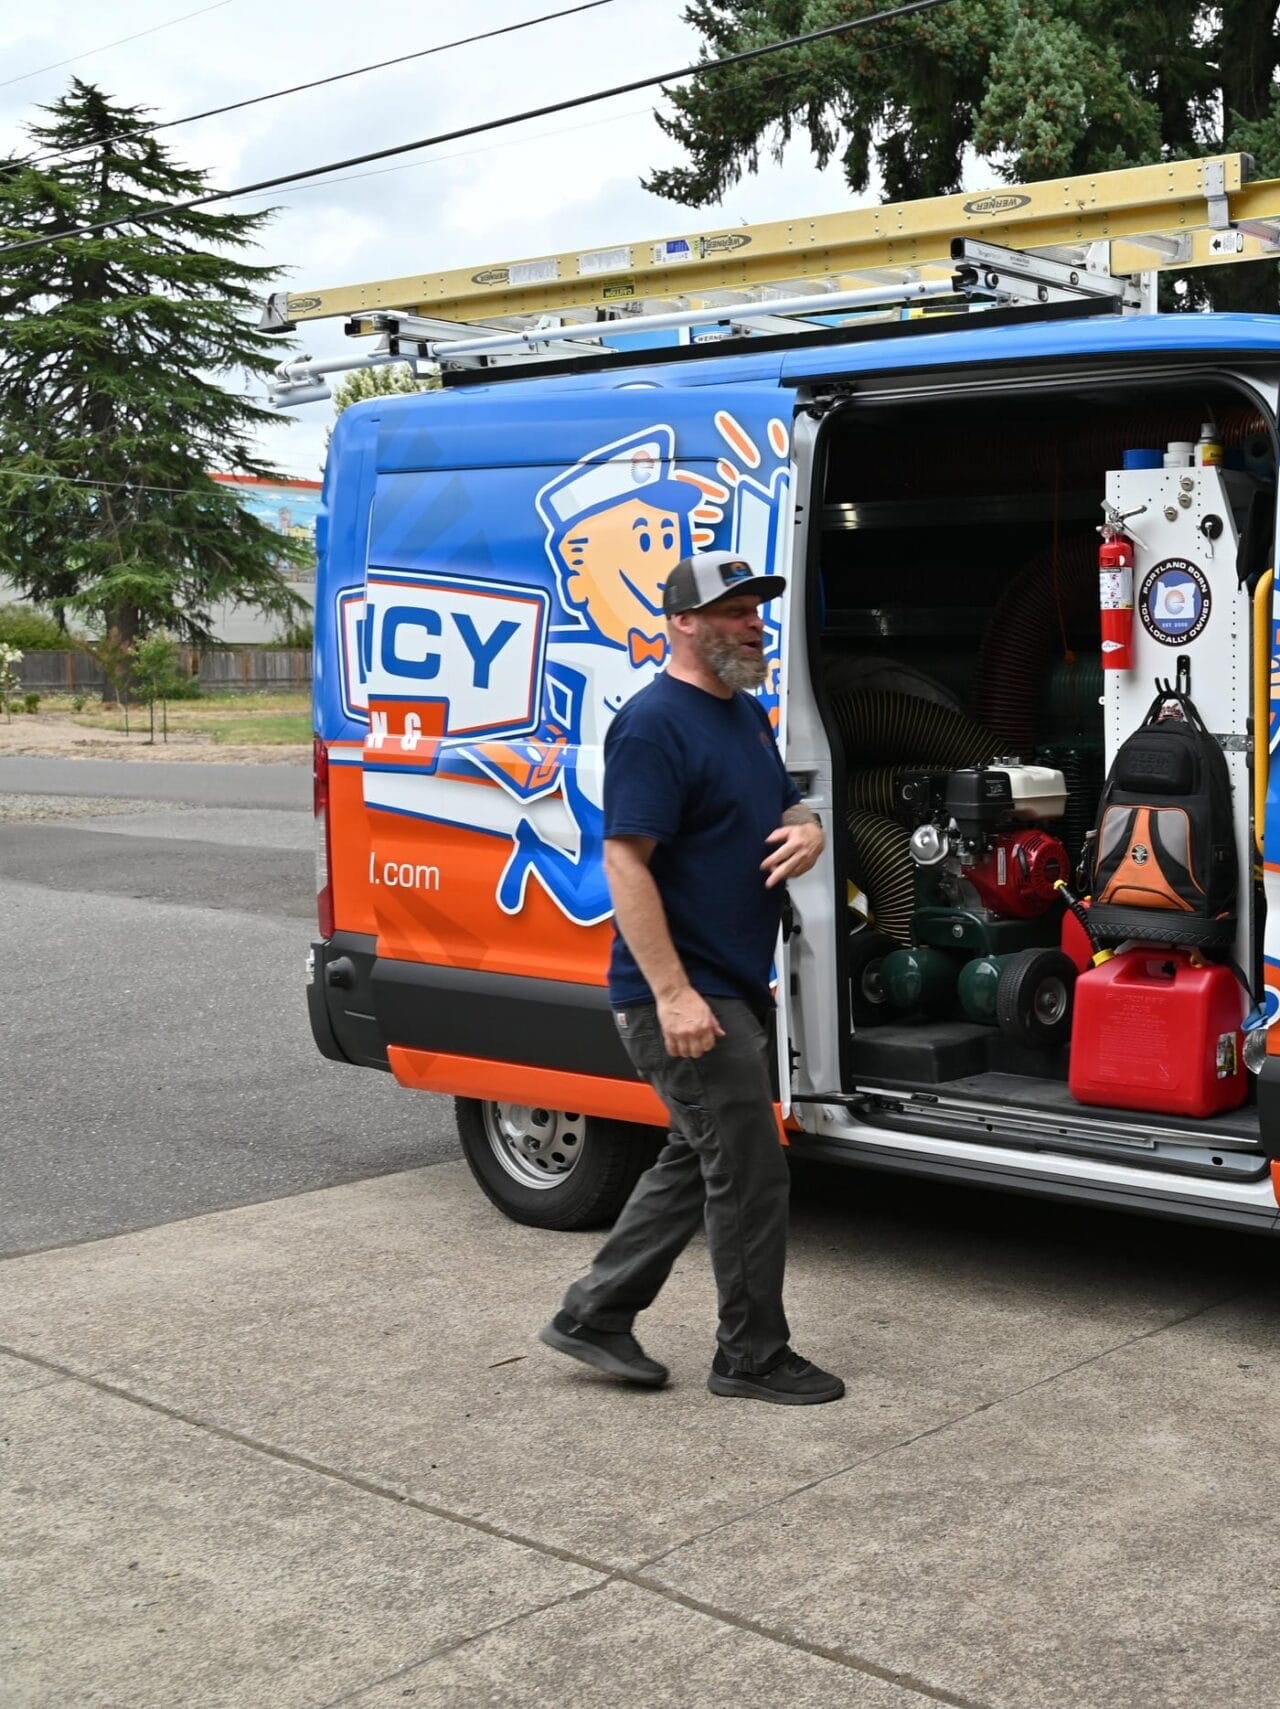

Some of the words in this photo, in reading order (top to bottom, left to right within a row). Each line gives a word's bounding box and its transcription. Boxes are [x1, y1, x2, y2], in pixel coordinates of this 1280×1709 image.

[976, 198, 1017, 211] WERNER
[1142, 561, 1187, 594] PORTLAND
[1188, 566, 1208, 593] BORN
[1149, 625, 1188, 644] LOCALLY
[1189, 599, 1209, 637] OWNED
